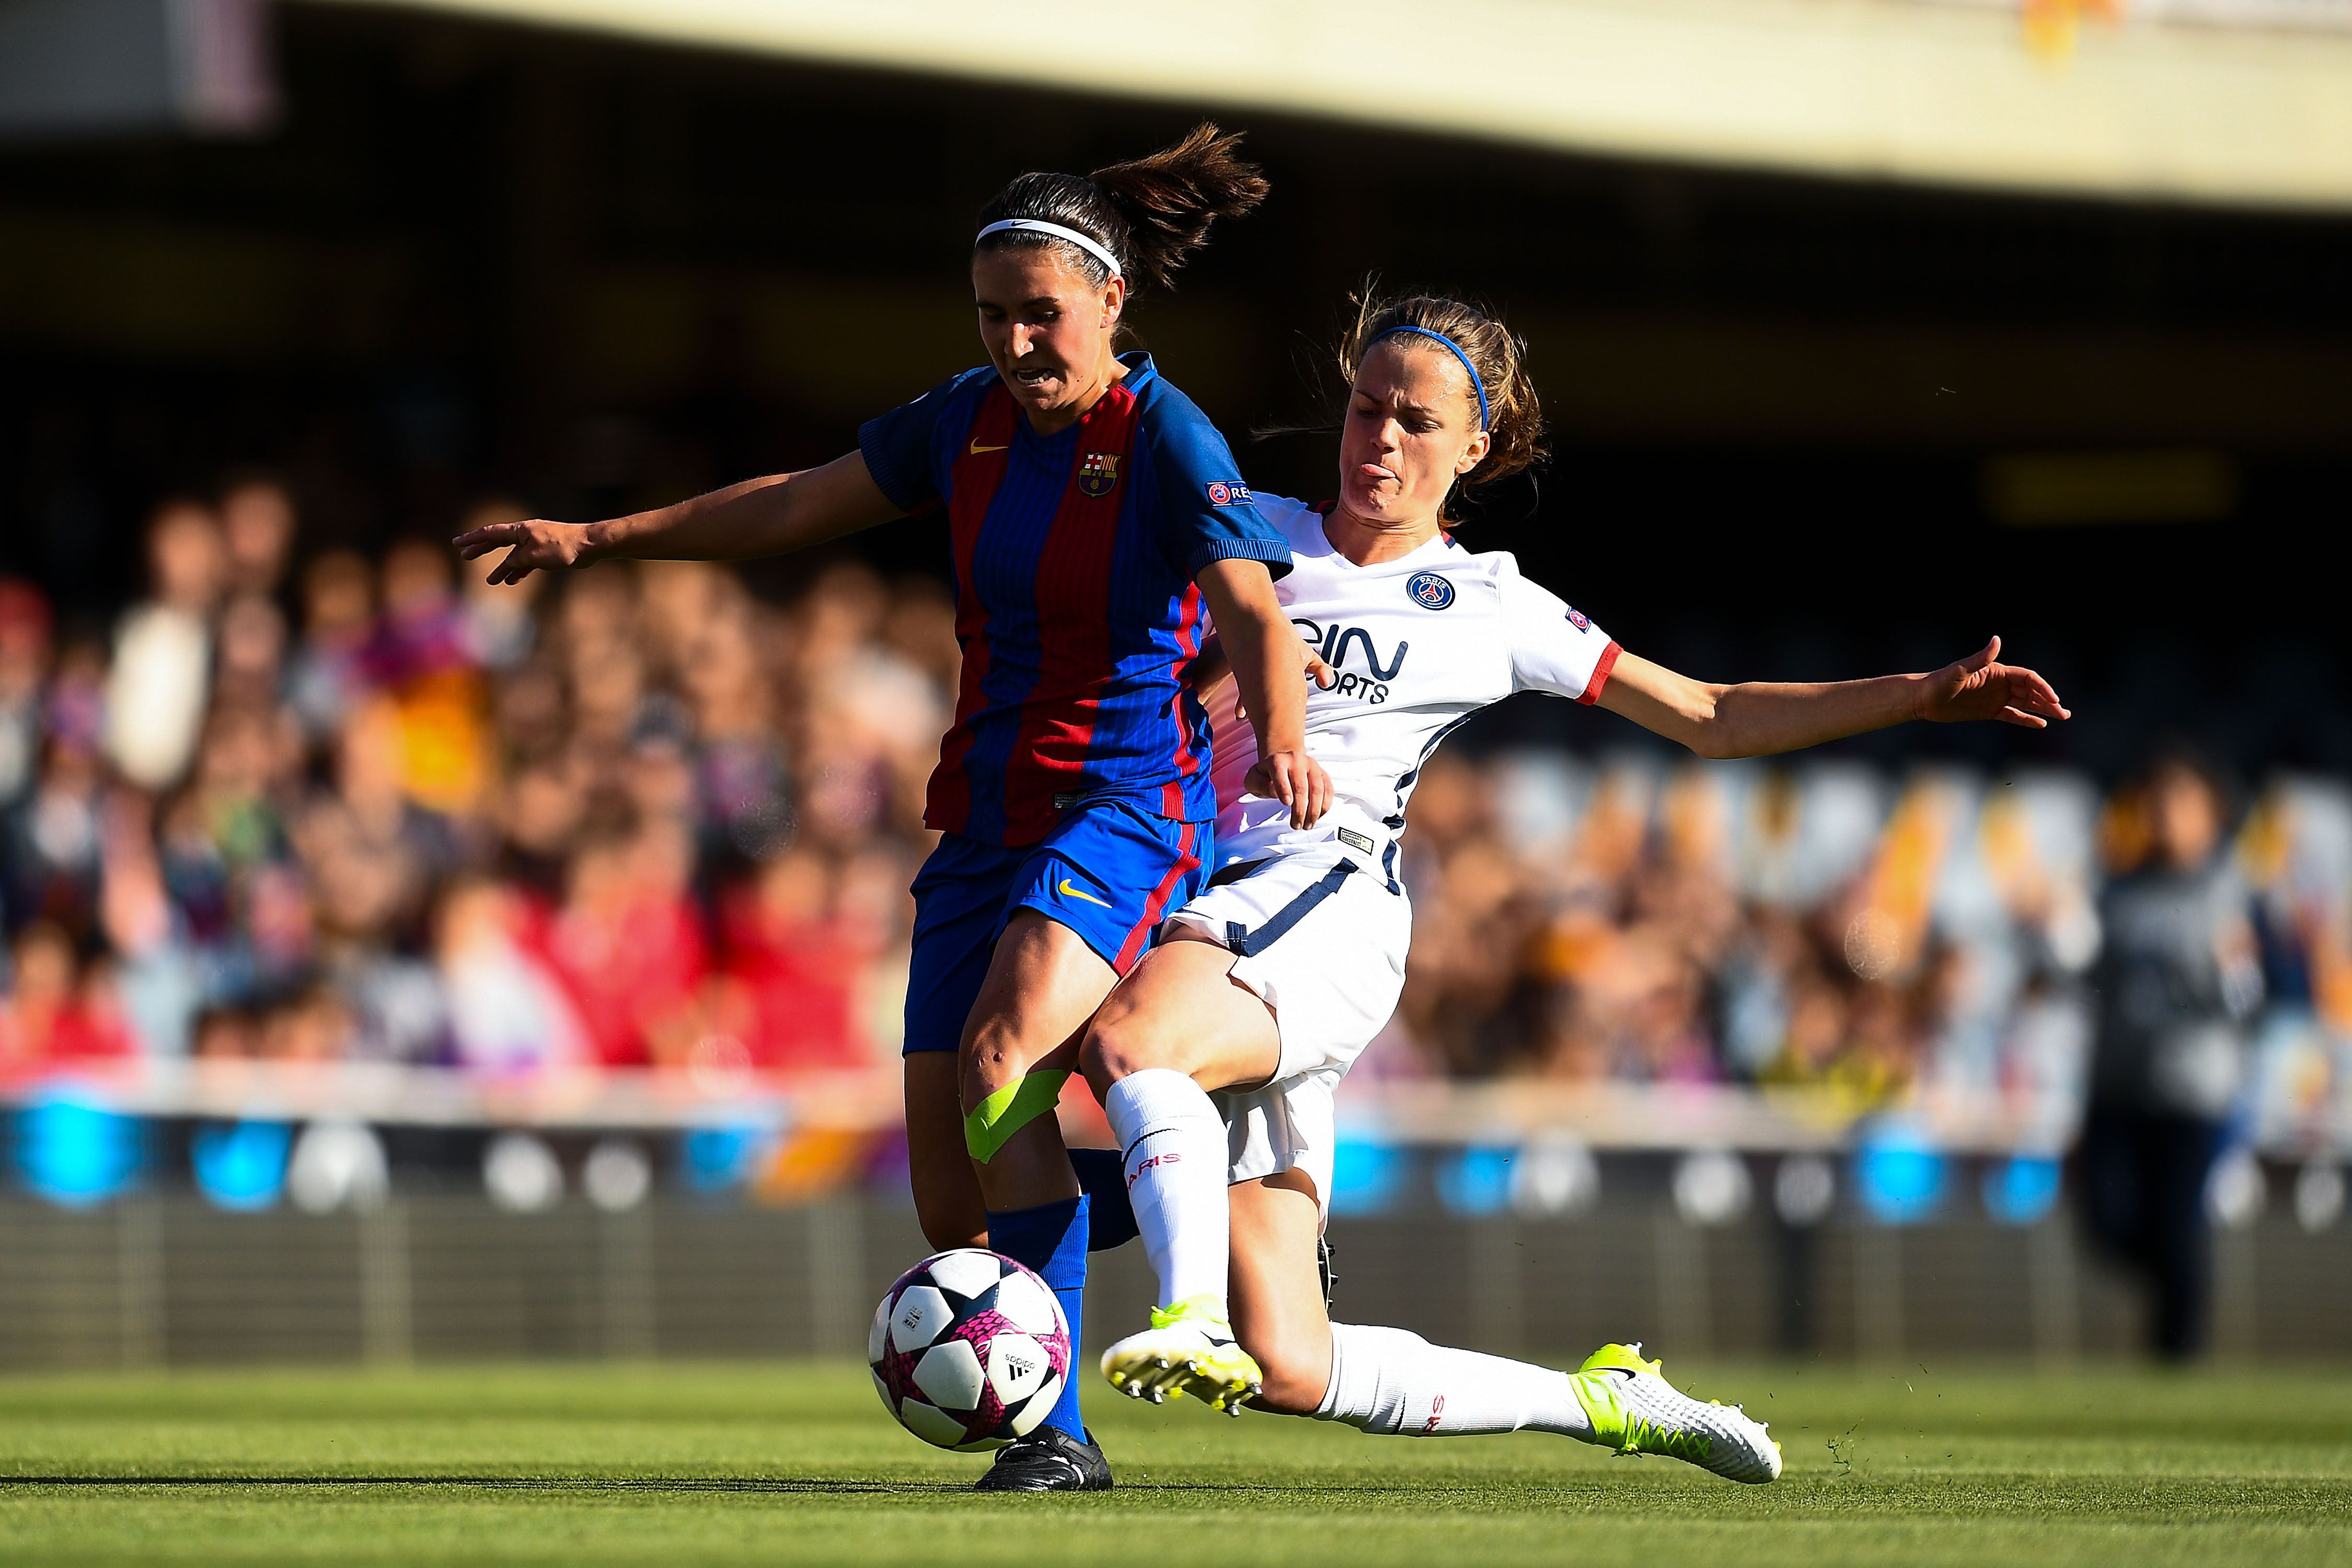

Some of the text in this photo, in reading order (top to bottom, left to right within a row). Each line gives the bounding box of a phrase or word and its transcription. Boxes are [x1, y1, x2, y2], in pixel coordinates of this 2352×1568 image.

[1420, 577, 1447, 589] PARIS
[1305, 670, 1389, 704] ORTS
[1005, 1354, 1035, 1369] adidas
